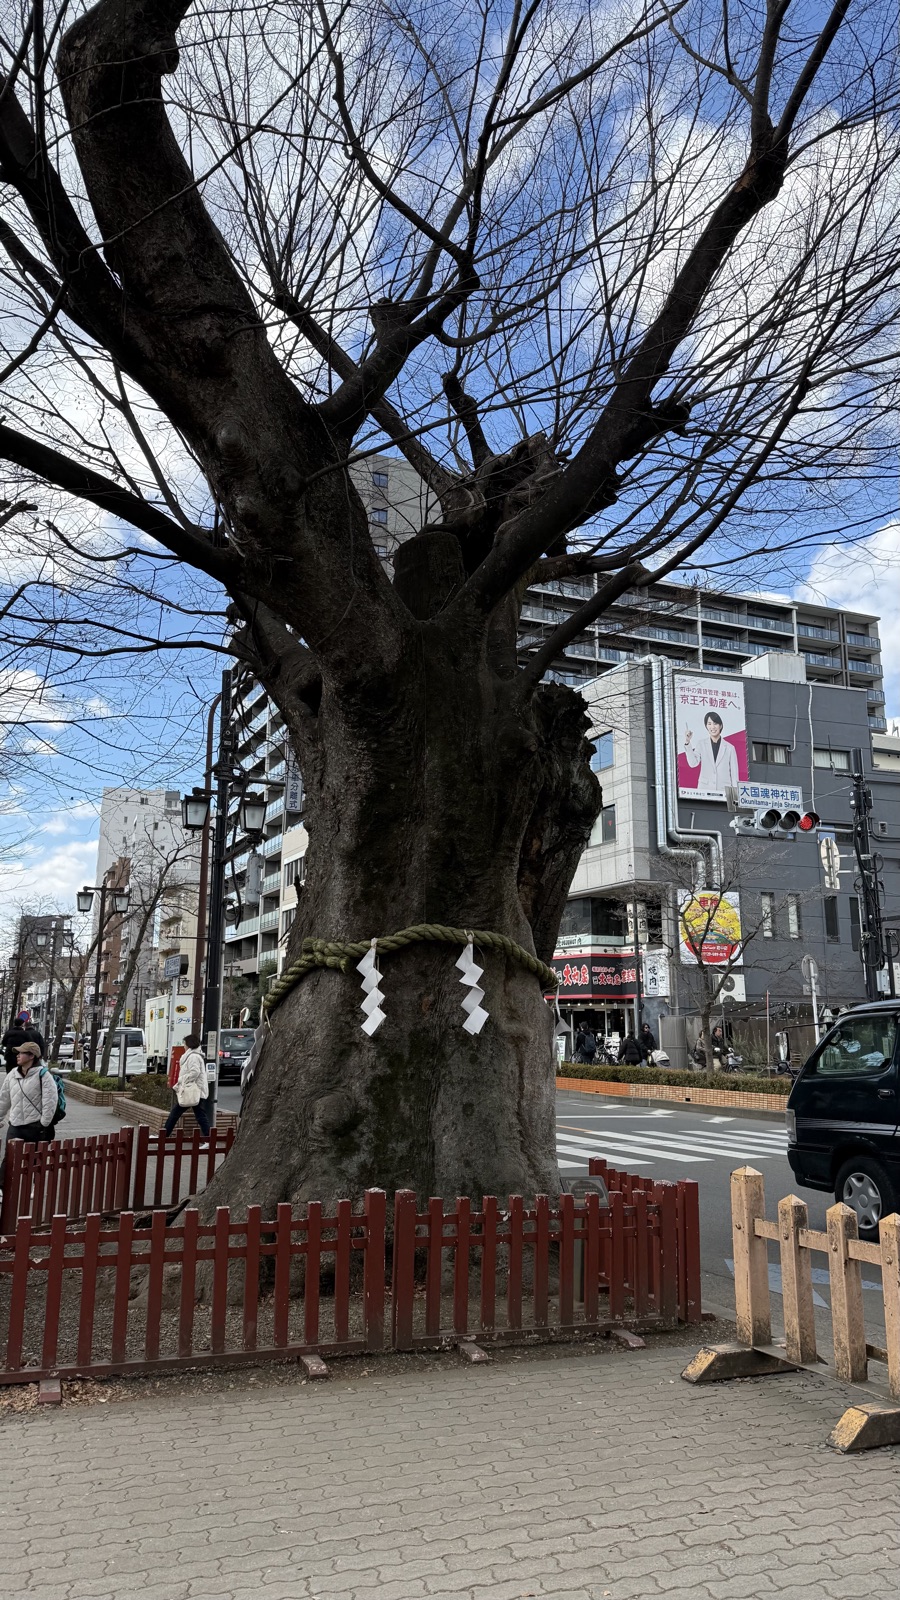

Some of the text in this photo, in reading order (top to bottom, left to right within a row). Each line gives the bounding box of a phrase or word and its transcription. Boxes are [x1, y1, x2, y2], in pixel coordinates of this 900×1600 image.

[680, 694, 741, 710] 京王不動産へ。
[740, 786, 800, 801] 大国魂神社前
